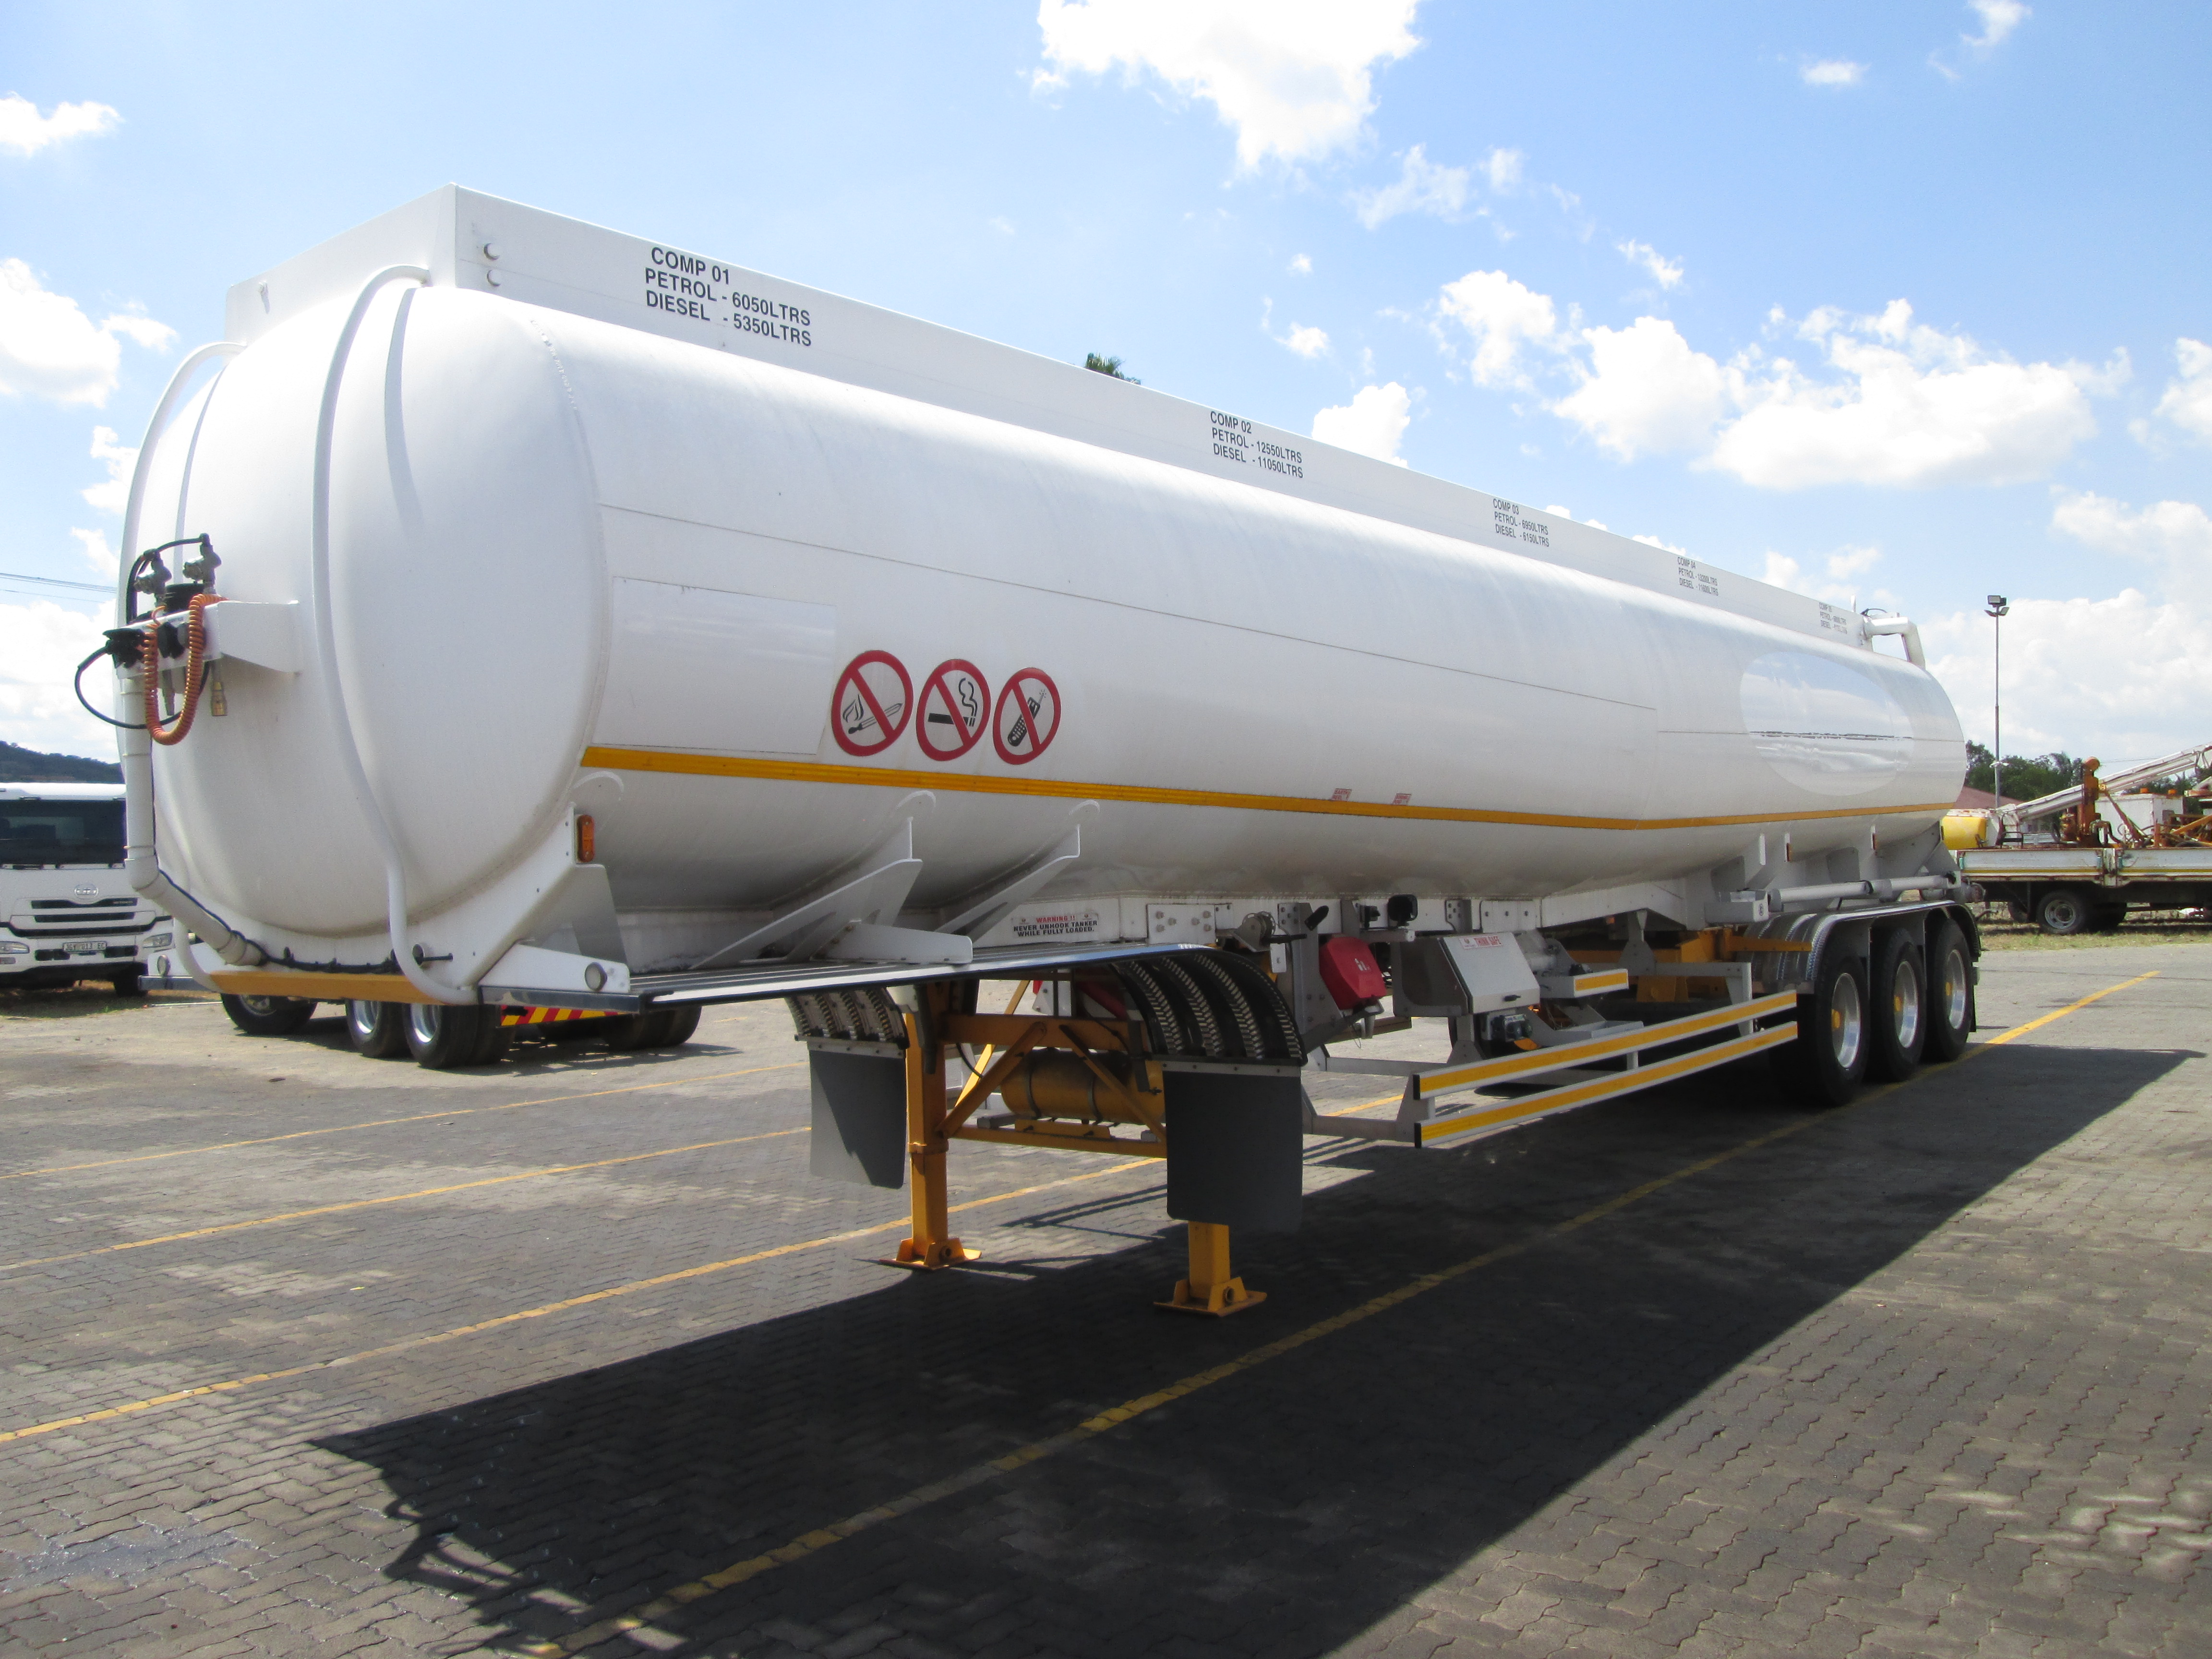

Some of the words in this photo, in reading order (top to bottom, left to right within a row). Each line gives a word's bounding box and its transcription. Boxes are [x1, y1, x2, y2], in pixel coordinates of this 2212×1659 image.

[651, 246, 706, 276] COMP
[712, 264, 729, 285] 01
[645, 267, 717, 301] PETROL
[732, 291, 811, 326] 6050LTRS
[646, 289, 710, 321] DIESEL
[733, 313, 812, 347] 5350LTRS
[1210, 411, 1238, 429] COMP
[1241, 421, 1252, 434] 02
[1212, 427, 1249, 448] PETROL
[1256, 441, 1302, 464] 12550LTRS
[1213, 443, 1247, 463] DIESEL
[1258, 456, 1303, 479] 11050LTRS
[1493, 498, 1511, 512] COMP
[1512, 505, 1519, 515] 03
[1494, 511, 1518, 527] PETROL
[1495, 524, 1516, 538] DIESEL
[1677, 556, 1690, 567] COMP
[1678, 567, 1695, 579] PETROL
[1679, 577, 1694, 589] DIESEL
